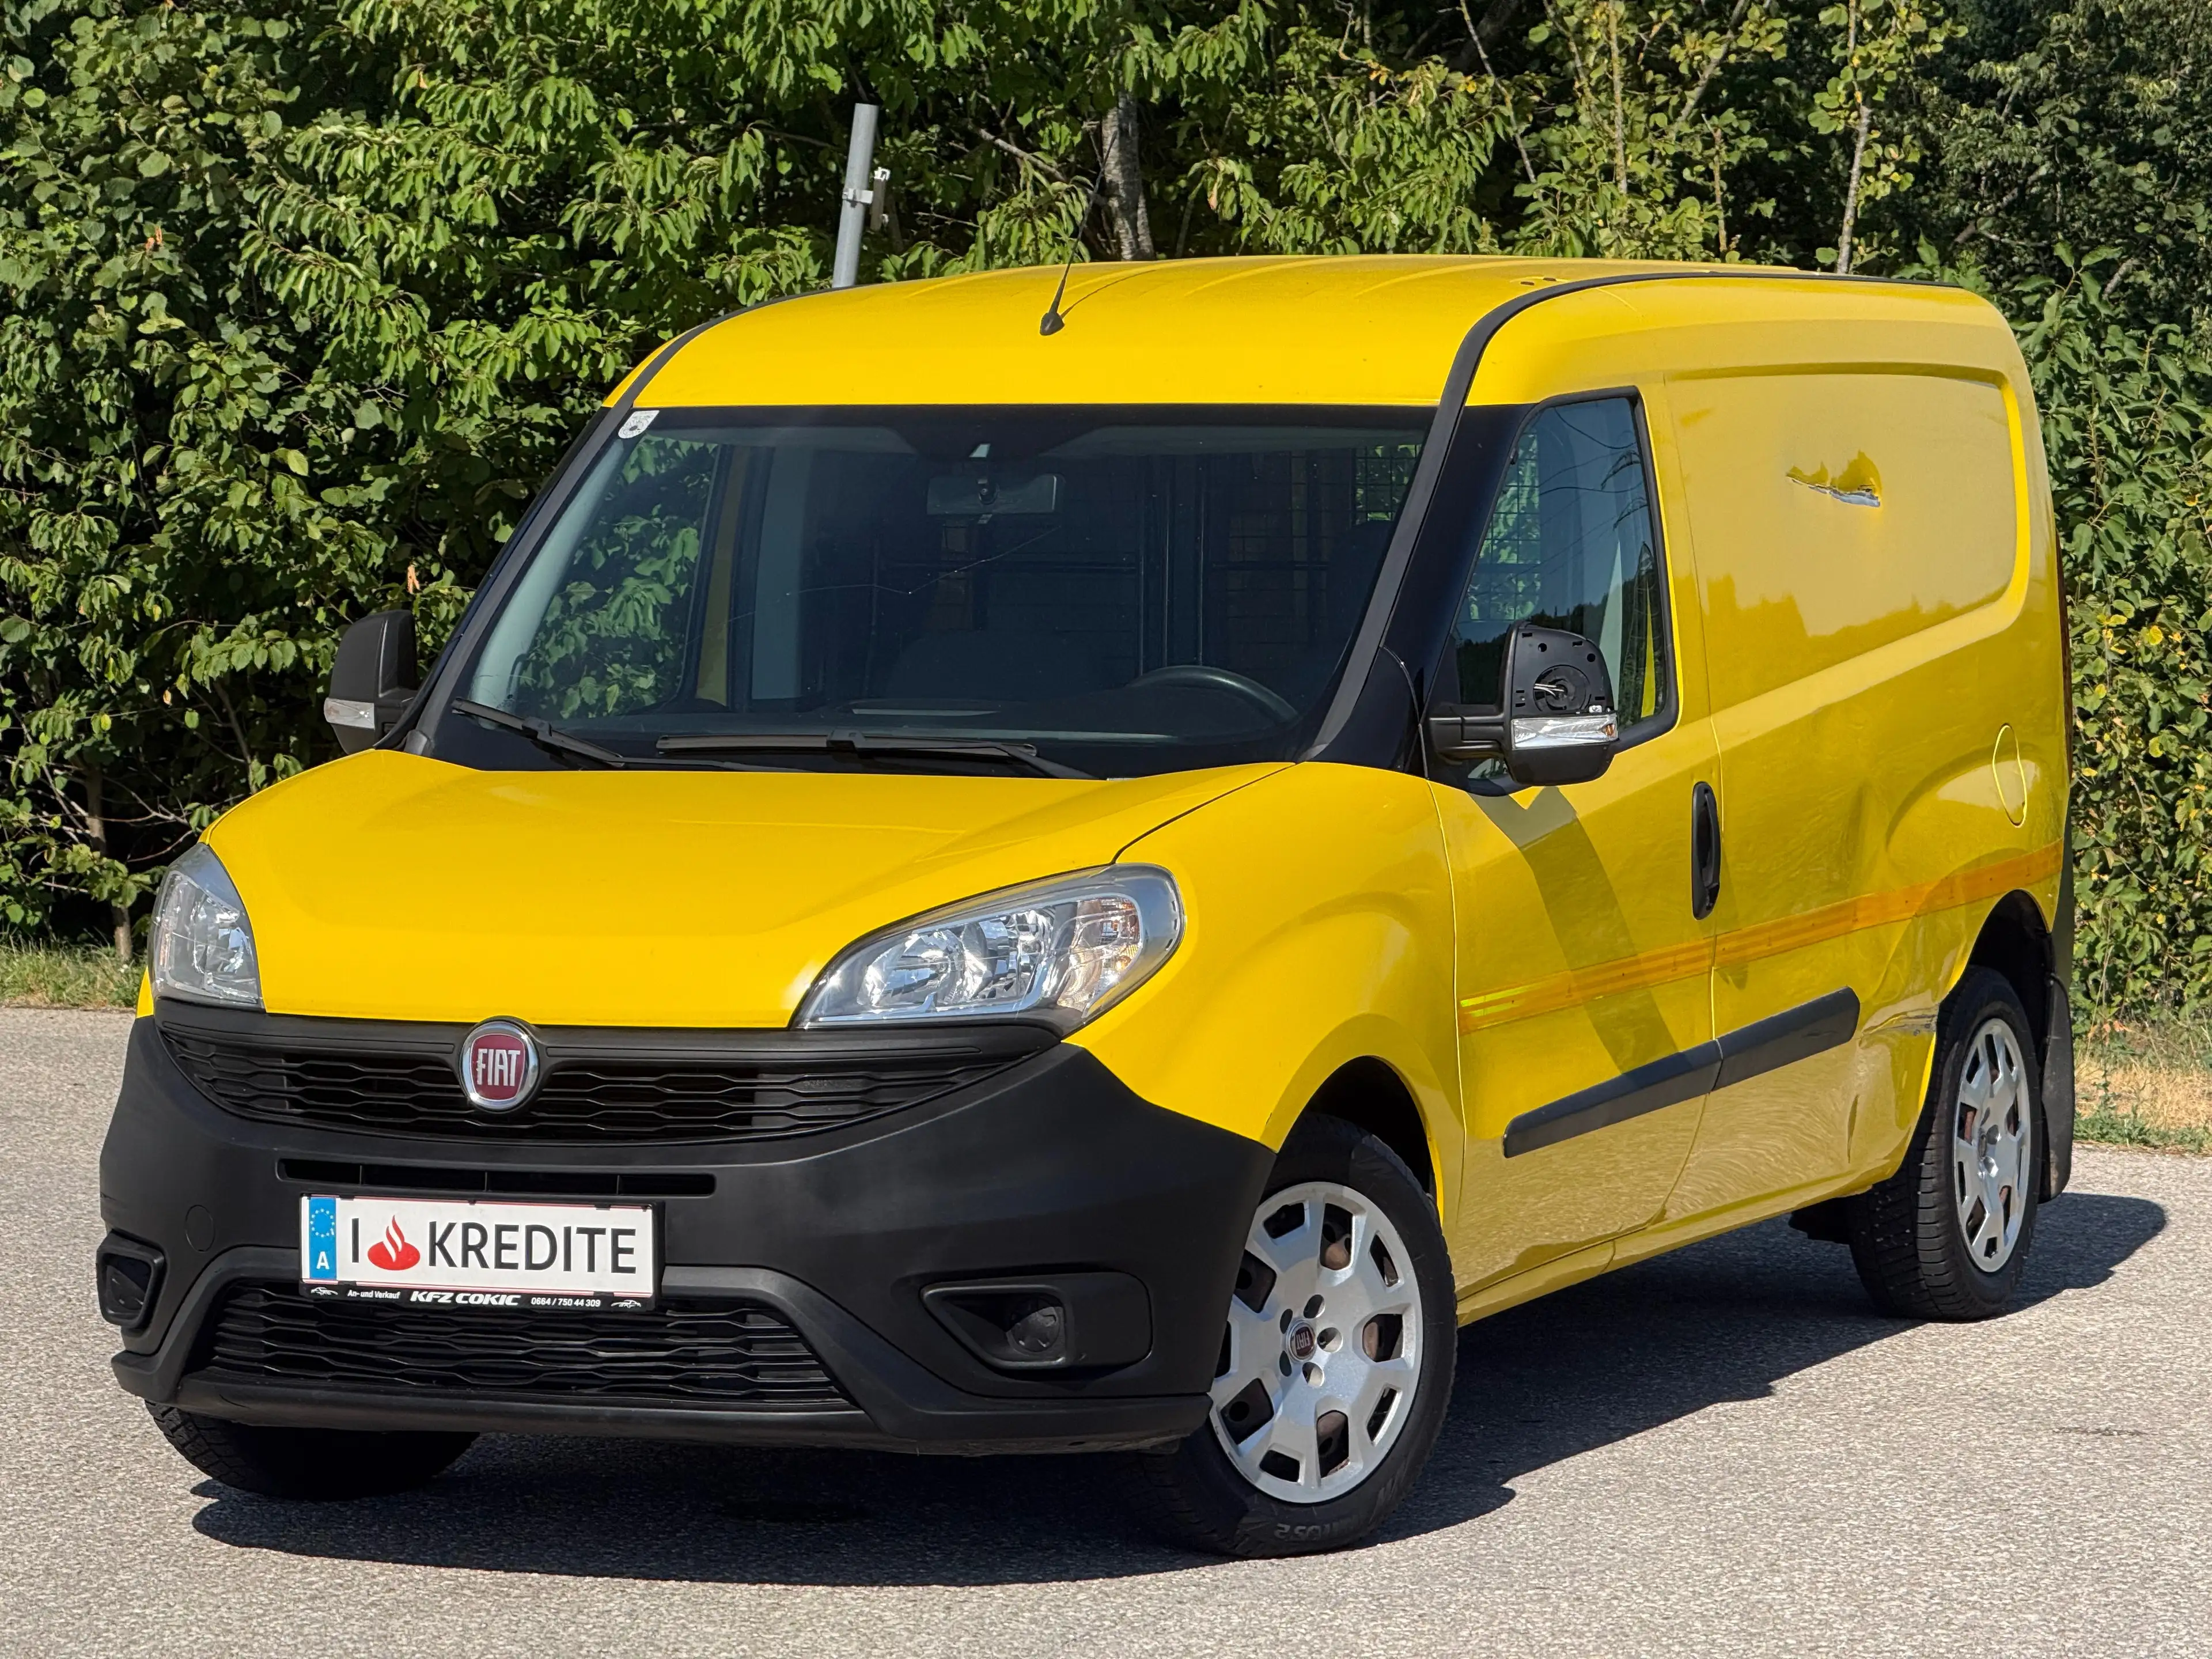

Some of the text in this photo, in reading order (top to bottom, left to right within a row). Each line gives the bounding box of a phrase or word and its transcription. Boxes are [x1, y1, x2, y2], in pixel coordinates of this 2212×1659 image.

[476, 1048, 521, 1086] FIAT
[353, 1218, 636, 1274] I KREDITE
[317, 1252, 329, 1269] A
[410, 1291, 454, 1302] KFZ
[456, 1293, 521, 1305] COKIC
[1296, 1331, 1310, 1350] FIAT
